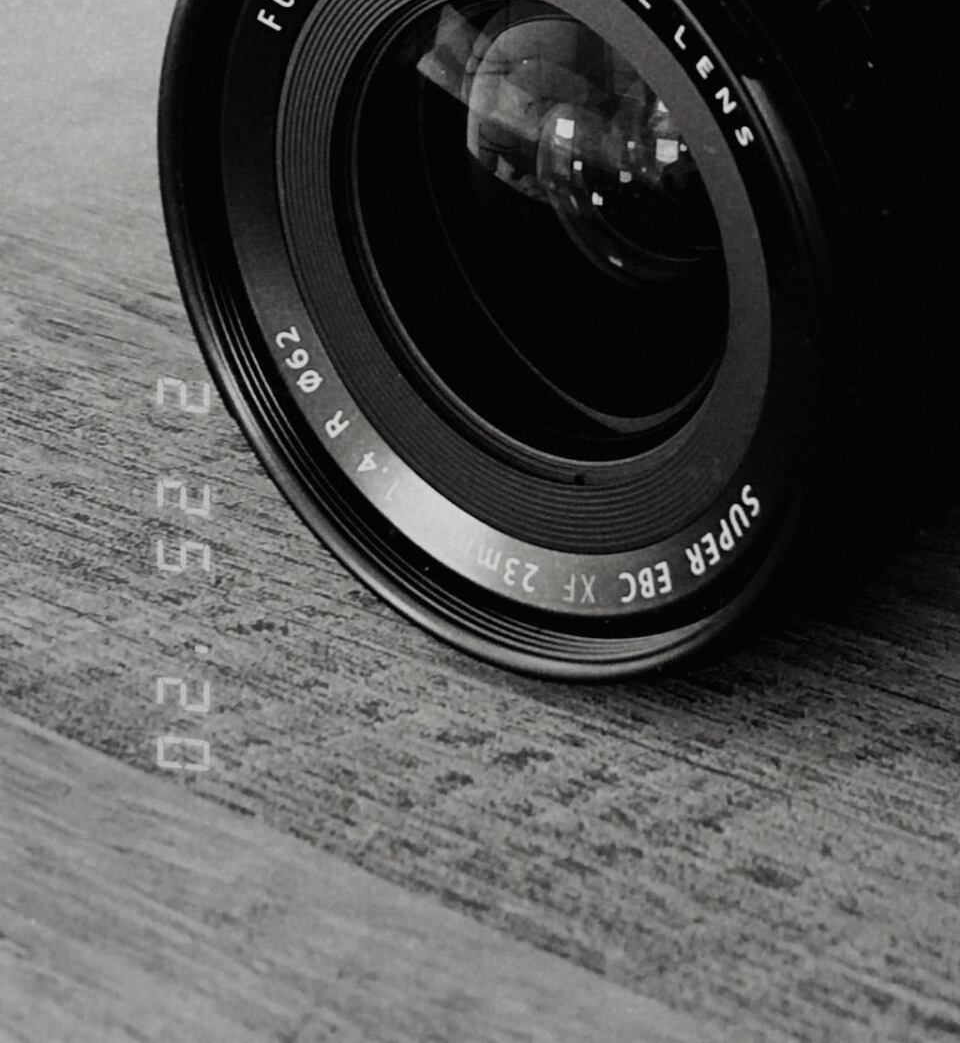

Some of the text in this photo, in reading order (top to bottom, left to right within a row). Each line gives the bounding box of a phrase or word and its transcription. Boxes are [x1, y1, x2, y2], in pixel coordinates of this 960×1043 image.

[673, 24, 756, 148] LENS
[324, 410, 351, 439] R
[684, 484, 761, 577] SUPER
[559, 571, 597, 604] XF
[617, 560, 673, 605] EBC
